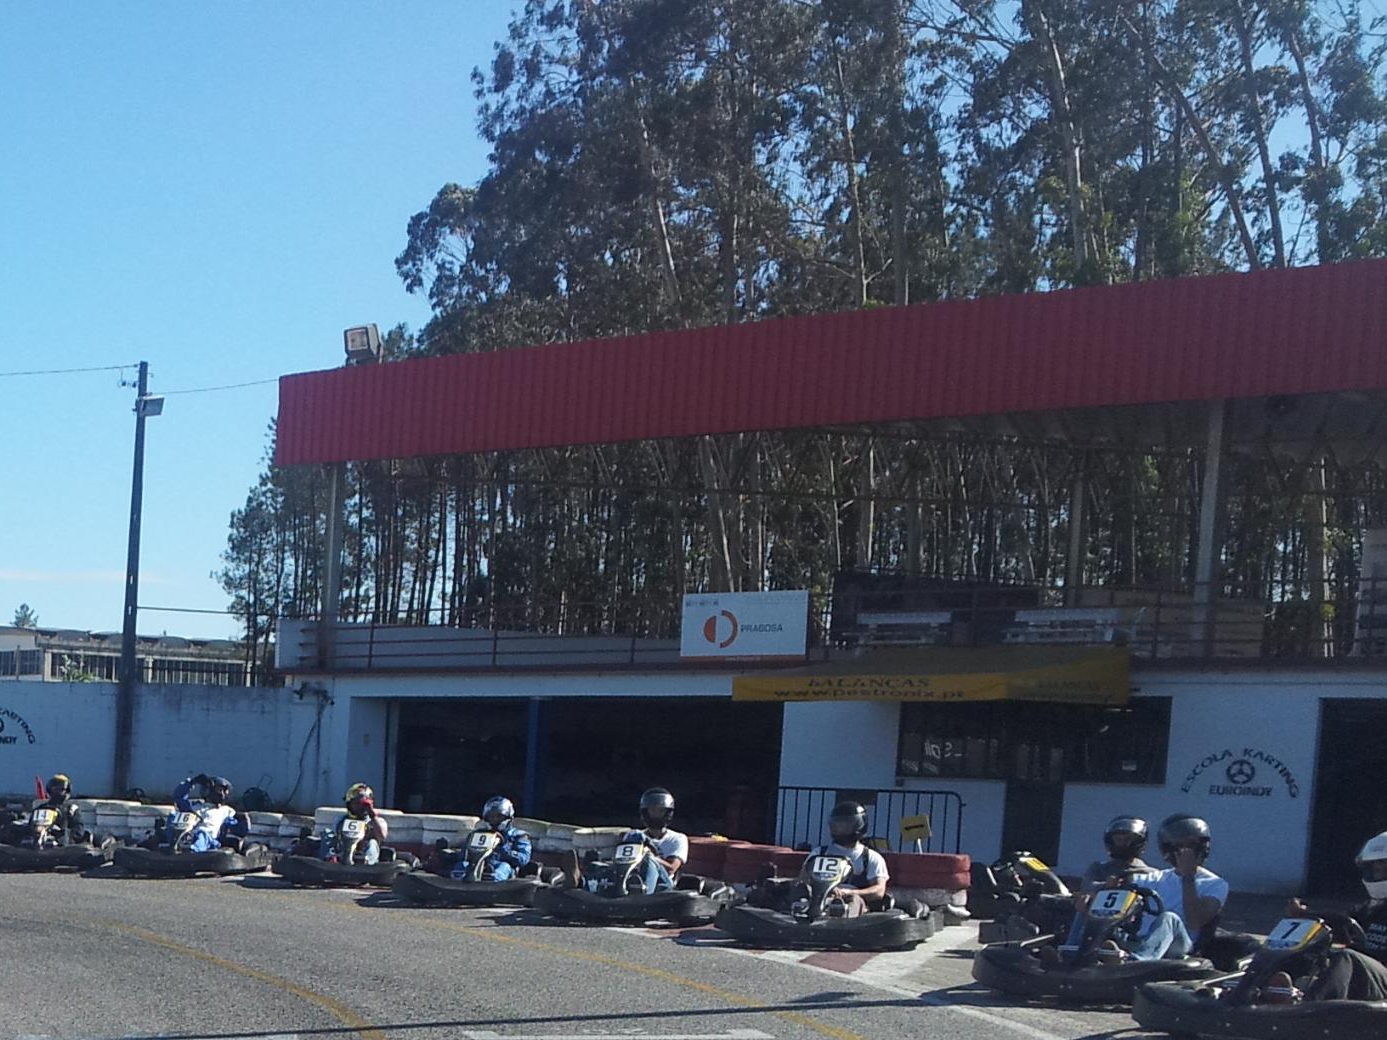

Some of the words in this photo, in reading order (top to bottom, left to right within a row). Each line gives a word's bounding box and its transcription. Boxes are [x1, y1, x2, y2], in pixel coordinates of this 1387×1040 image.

[1181, 749, 1233, 793] ESCOLA
[1242, 748, 1299, 798] KARTING
[1209, 785, 1273, 797] EUROINDY
[174, 812, 189, 824] 16
[348, 821, 357, 831] 6
[477, 835, 487, 846] 9
[621, 845, 634, 857] 8
[817, 858, 839, 872] 12
[1103, 892, 1118, 909] 5
[1280, 922, 1301, 940] 7
